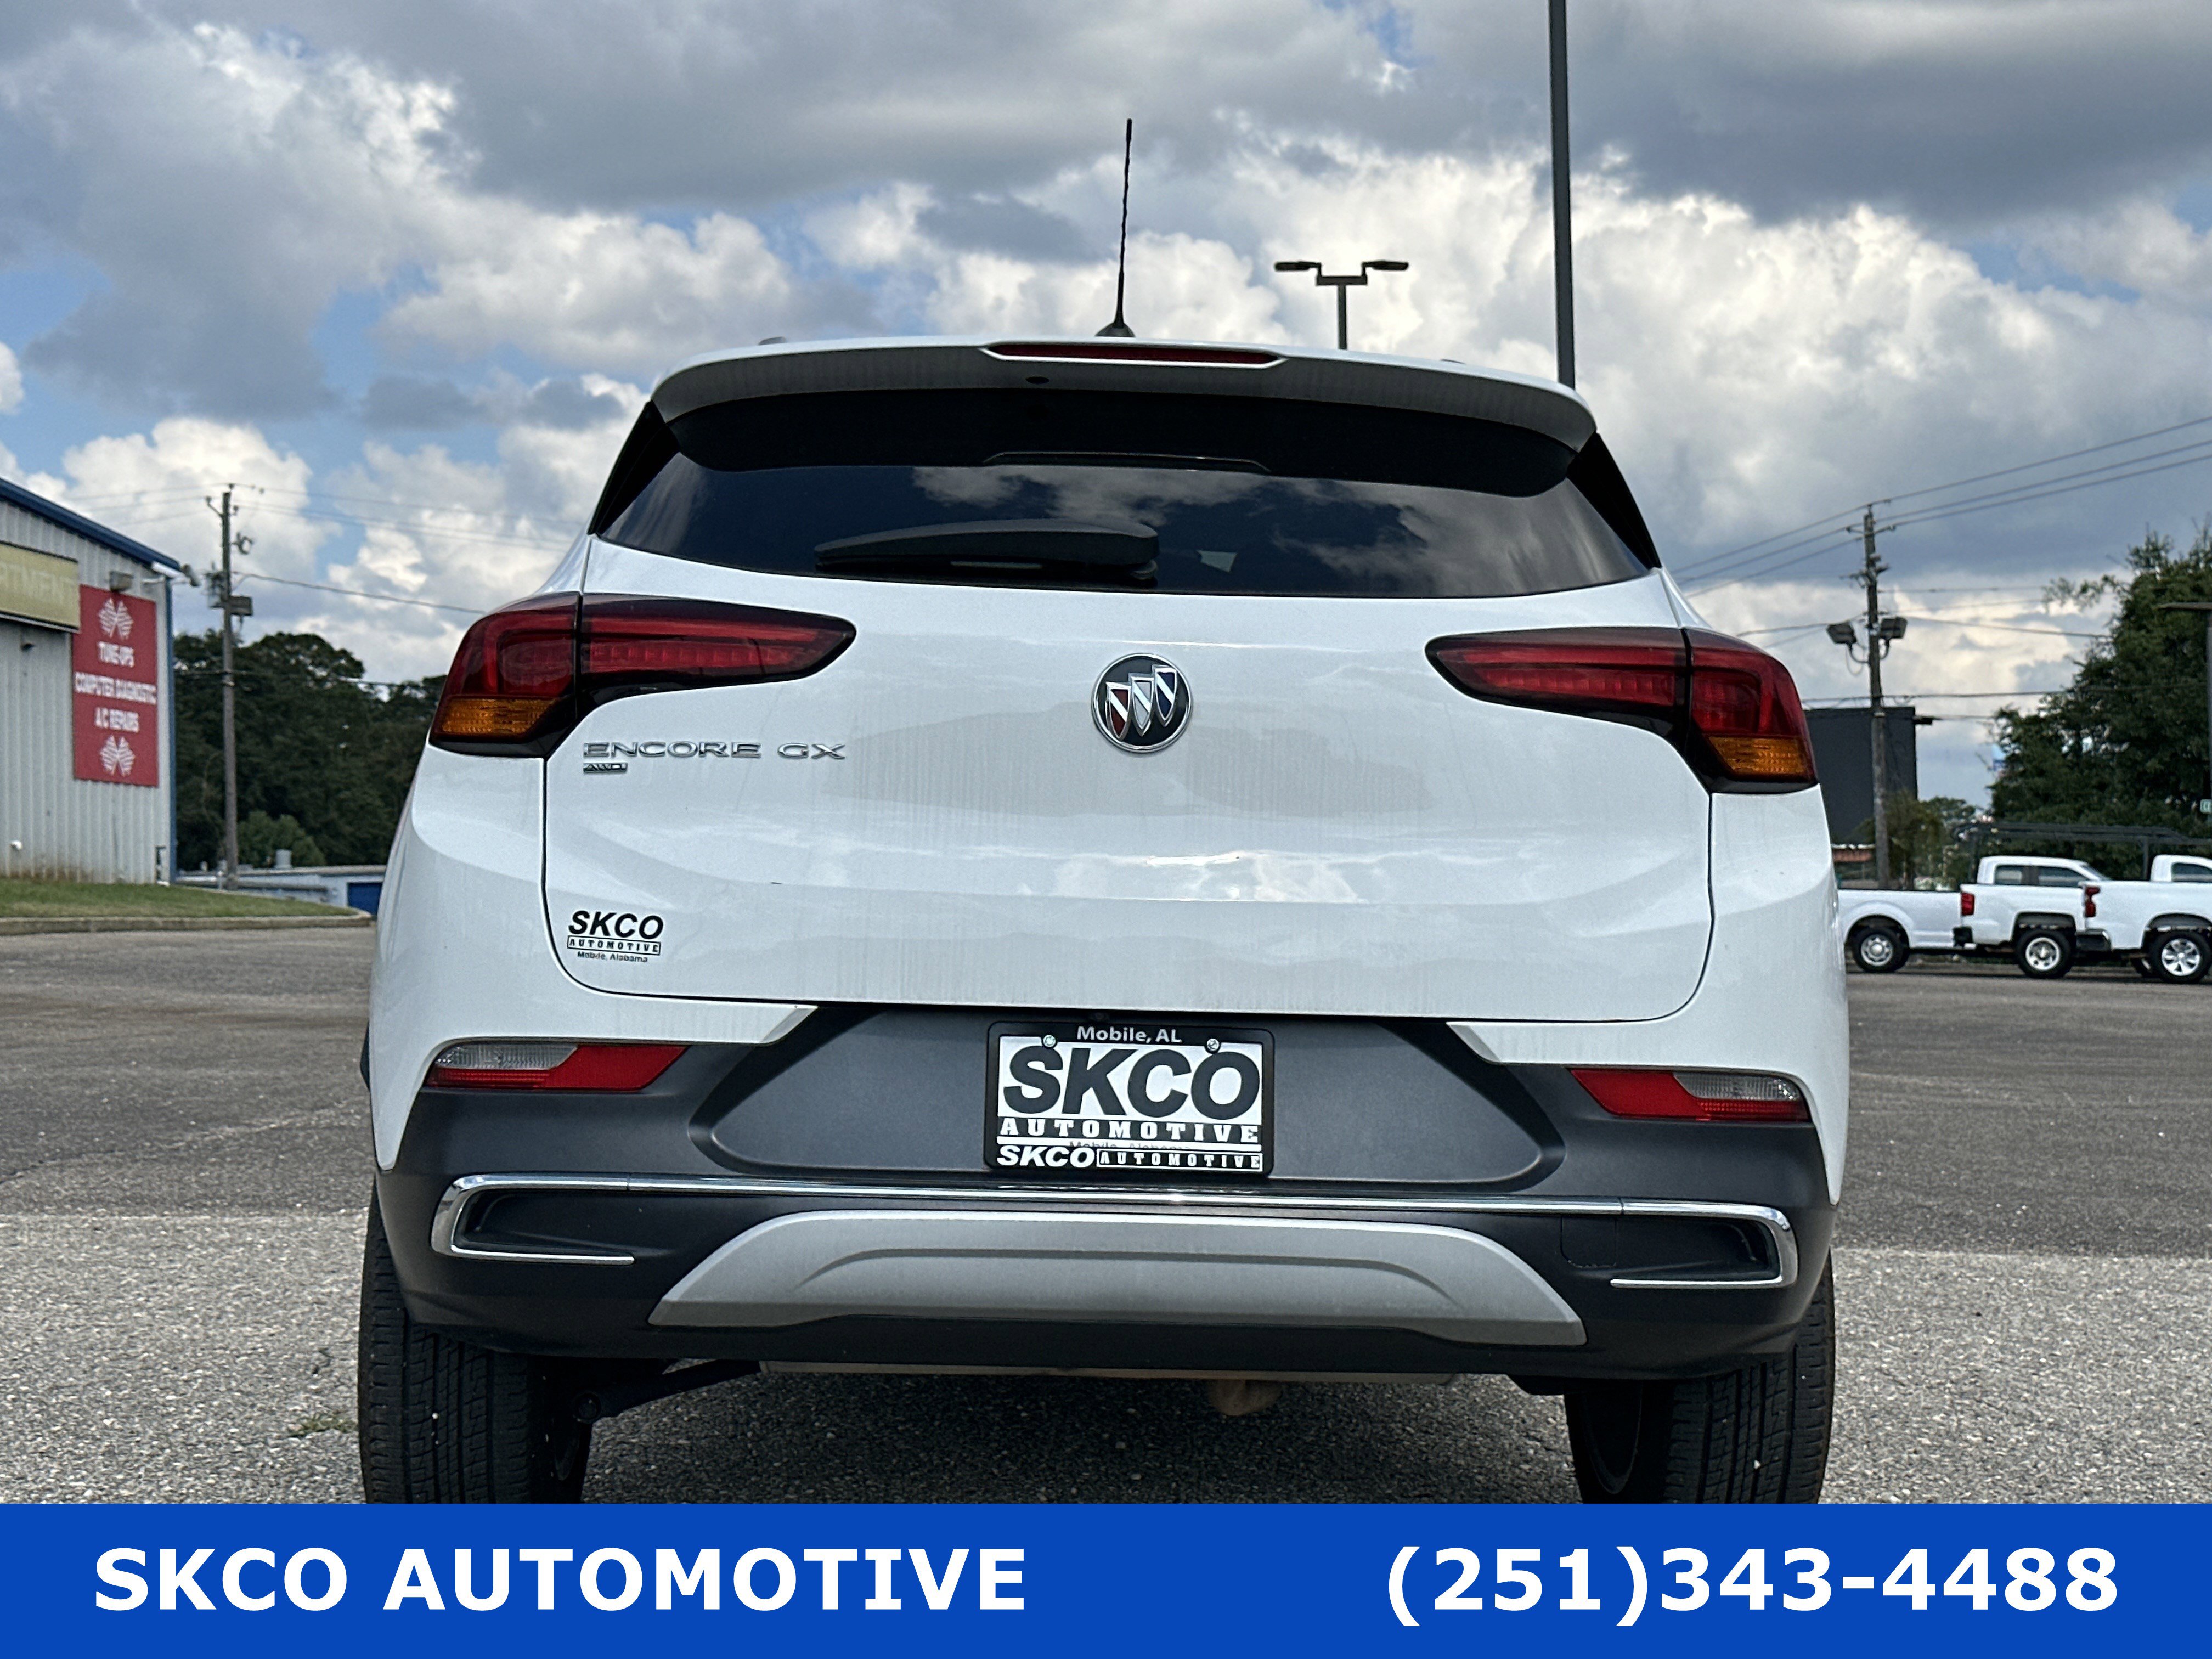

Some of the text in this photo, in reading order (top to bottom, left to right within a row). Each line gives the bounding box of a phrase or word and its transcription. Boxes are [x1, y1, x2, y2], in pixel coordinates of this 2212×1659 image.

[75, 672, 115, 698] COMPUTER
[583, 741, 845, 760] ENCORE GX
[583, 763, 625, 774] AWD
[568, 910, 664, 940] SKCO
[569, 938, 659, 952] AUTOMOTIVE
[610, 953, 648, 962] Alabama
[1077, 1026, 1182, 1043] Mobile, AL
[1003, 1045, 1260, 1120] SKCO
[1000, 1118, 1258, 1143] AUTOMOTIVE
[997, 1145, 1261, 1169] SKCO AUTOMOTIVE
